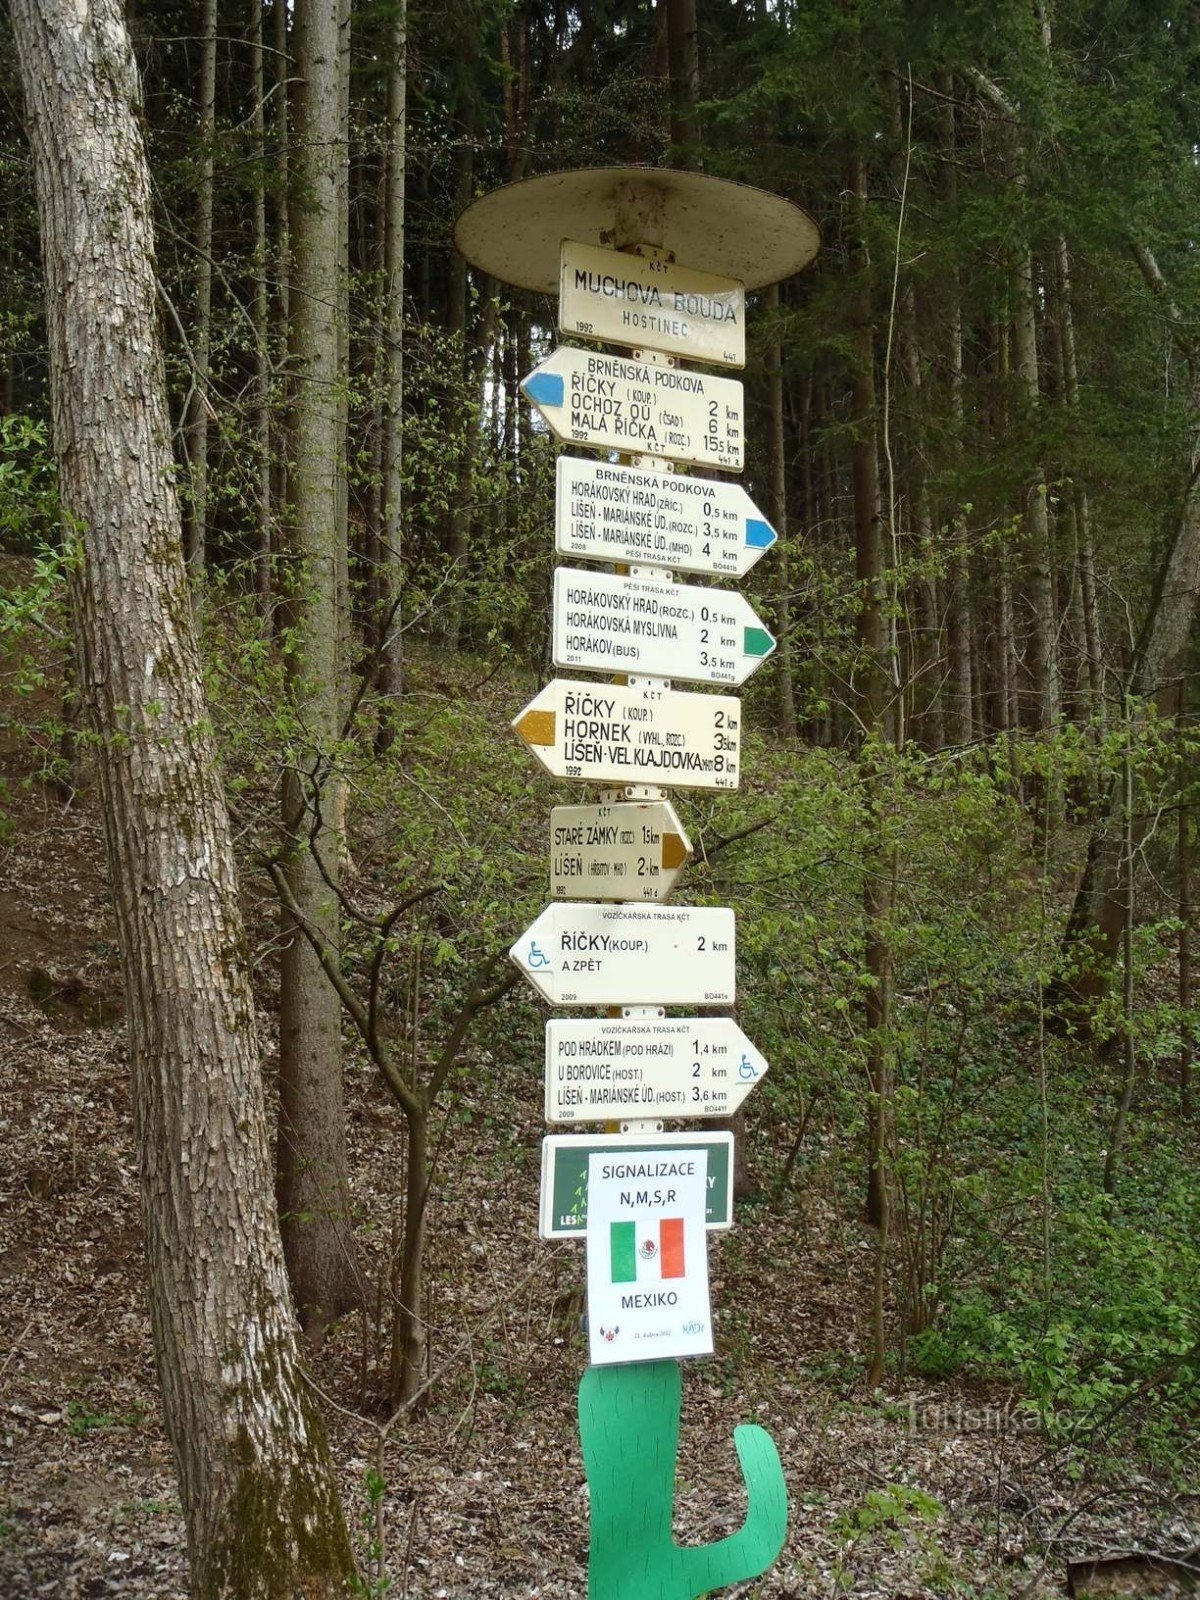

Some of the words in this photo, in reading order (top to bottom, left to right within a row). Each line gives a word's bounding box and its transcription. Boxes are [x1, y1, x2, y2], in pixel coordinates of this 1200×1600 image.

[575, 270, 662, 307] MUCHOVA
[674, 292, 737, 325] BOUDA
[576, 321, 593, 333] 1992
[623, 311, 688, 336] HOSTINEC
[588, 358, 650, 384] BRNĚNSKÁ
[655, 372, 704, 394] PODKOVA
[572, 371, 616, 396] ŘÍČKY
[709, 401, 718, 417] 2
[726, 406, 738, 420] km
[572, 393, 622, 416] OCHOZ
[709, 419, 718, 434] 6
[727, 424, 739, 438] km
[572, 412, 607, 432] MALÁ
[615, 416, 656, 441] ŘÍČKA
[727, 440, 739, 455] km
[572, 429, 588, 440] 1992
[596, 469, 659, 489] BRNĚNSKÁ
[662, 481, 715, 498] PODKOVA
[572, 480, 631, 503] HORÁKOVSKÝ
[703, 502, 720, 518] 0,5
[723, 510, 738, 520] km
[572, 501, 595, 519] LÍŠEŇ
[604, 506, 652, 528] MARIÁNSKÉ
[703, 522, 720, 538] 3,5
[723, 530, 738, 541] km
[571, 522, 595, 540] LÍŠEŇ
[603, 528, 652, 549] MARIÁNSKÉ
[702, 545, 710, 556] 4
[723, 551, 738, 561] km
[643, 552, 665, 562] TRASA
[642, 585, 664, 594] TRASA
[567, 587, 631, 611] HORÁKOVSKÝ
[701, 607, 718, 623] 0,5
[721, 614, 736, 625] km
[567, 611, 631, 634] HORÁKOVSKÁ
[633, 621, 678, 639] MYSLIVNA
[701, 630, 708, 643] 2
[720, 635, 735, 647] km
[700, 652, 717, 668] 3,5
[720, 658, 735, 669] km
[565, 692, 615, 718] ŘÍČKY
[714, 711, 724, 729] 2
[727, 716, 738, 729] km
[565, 719, 631, 743] HORNEK
[566, 766, 582, 776] 1992
[714, 755, 724, 772] 8
[726, 759, 736, 773] km
[555, 822, 582, 845] STARÉ
[586, 822, 618, 845] ZÁMKY
[555, 853, 582, 876] LÍŠEŇ
[638, 857, 645, 876] 2
[650, 858, 659, 876] km
[677, 913, 690, 921] KČT
[698, 937, 706, 951] 2
[712, 941, 727, 951] km
[562, 961, 570, 971] A
[573, 958, 602, 972] ZPĚT
[652, 1026, 675, 1034] TRASA
[676, 1025, 690, 1034] KČT
[558, 1041, 577, 1057] POD
[693, 1039, 709, 1055] 1,4
[712, 1045, 727, 1054] km
[558, 1065, 564, 1080] U
[567, 1064, 611, 1080] BOROVICE
[693, 1063, 700, 1078] 2
[712, 1068, 727, 1077] km
[558, 1087, 582, 1105] LÍŠEŇ
[590, 1085, 639, 1104] MARIÁNSKÉ
[692, 1087, 708, 1102] 3,6
[712, 1091, 727, 1100] km
[602, 1162, 695, 1179] SIGNALIZACE
[622, 1292, 677, 1309] MEXIKO
